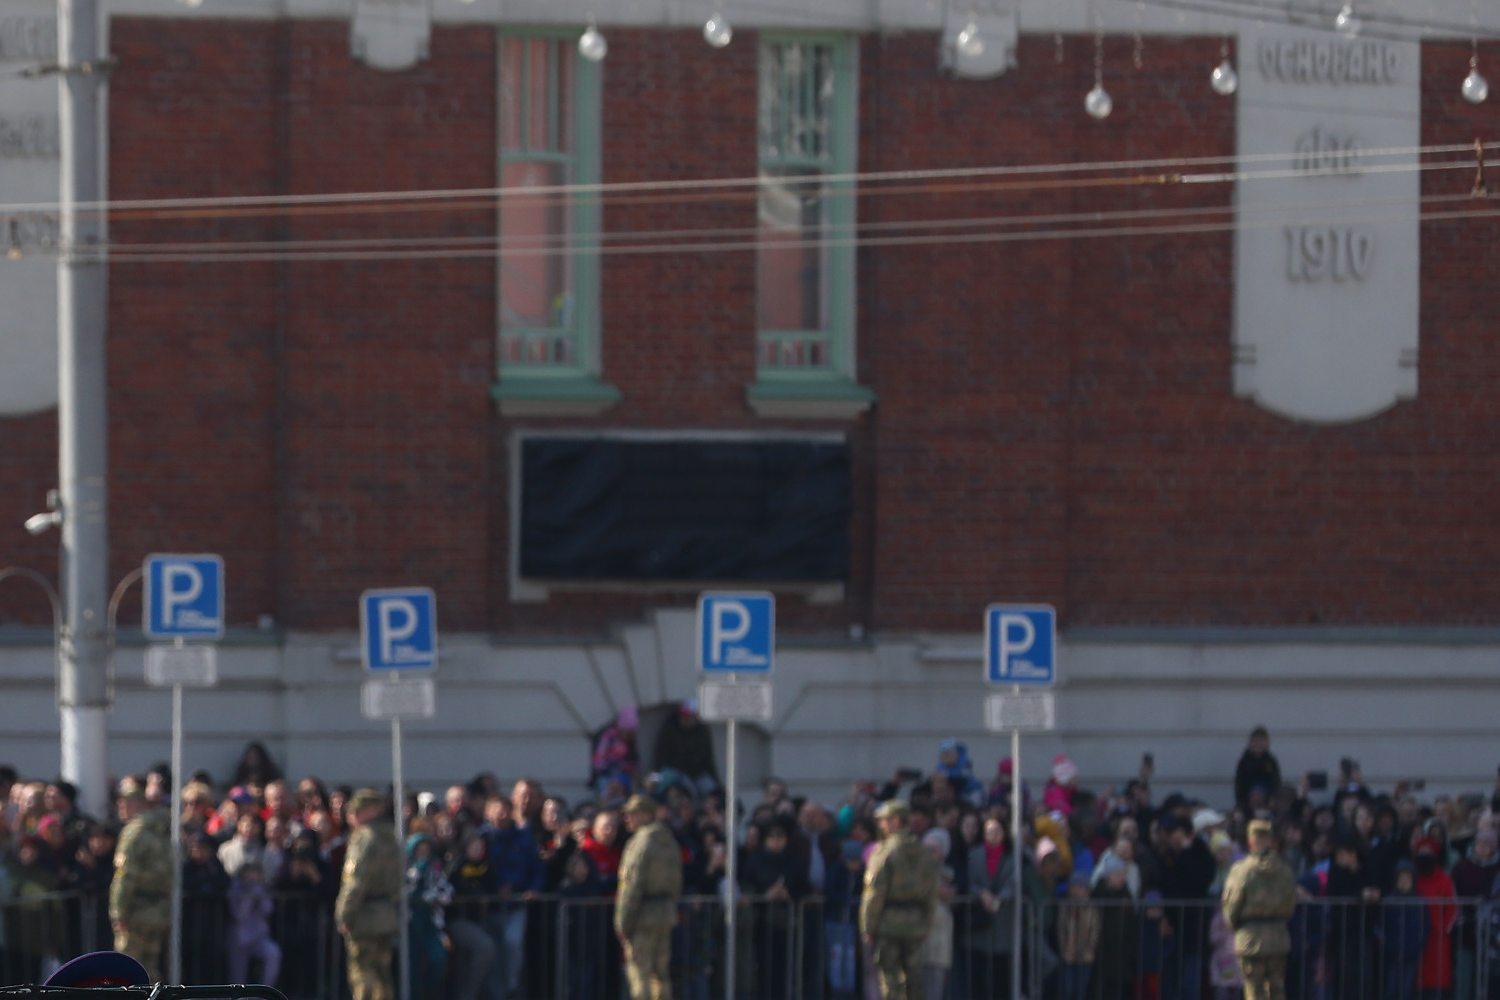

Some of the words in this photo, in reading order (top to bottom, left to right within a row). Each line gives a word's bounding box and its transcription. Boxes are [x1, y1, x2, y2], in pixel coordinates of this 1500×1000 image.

[1282, 224, 1376, 284] 1910
[161, 563, 203, 628] P
[377, 598, 418, 663] P
[710, 601, 751, 664] P
[998, 614, 1036, 677] P
